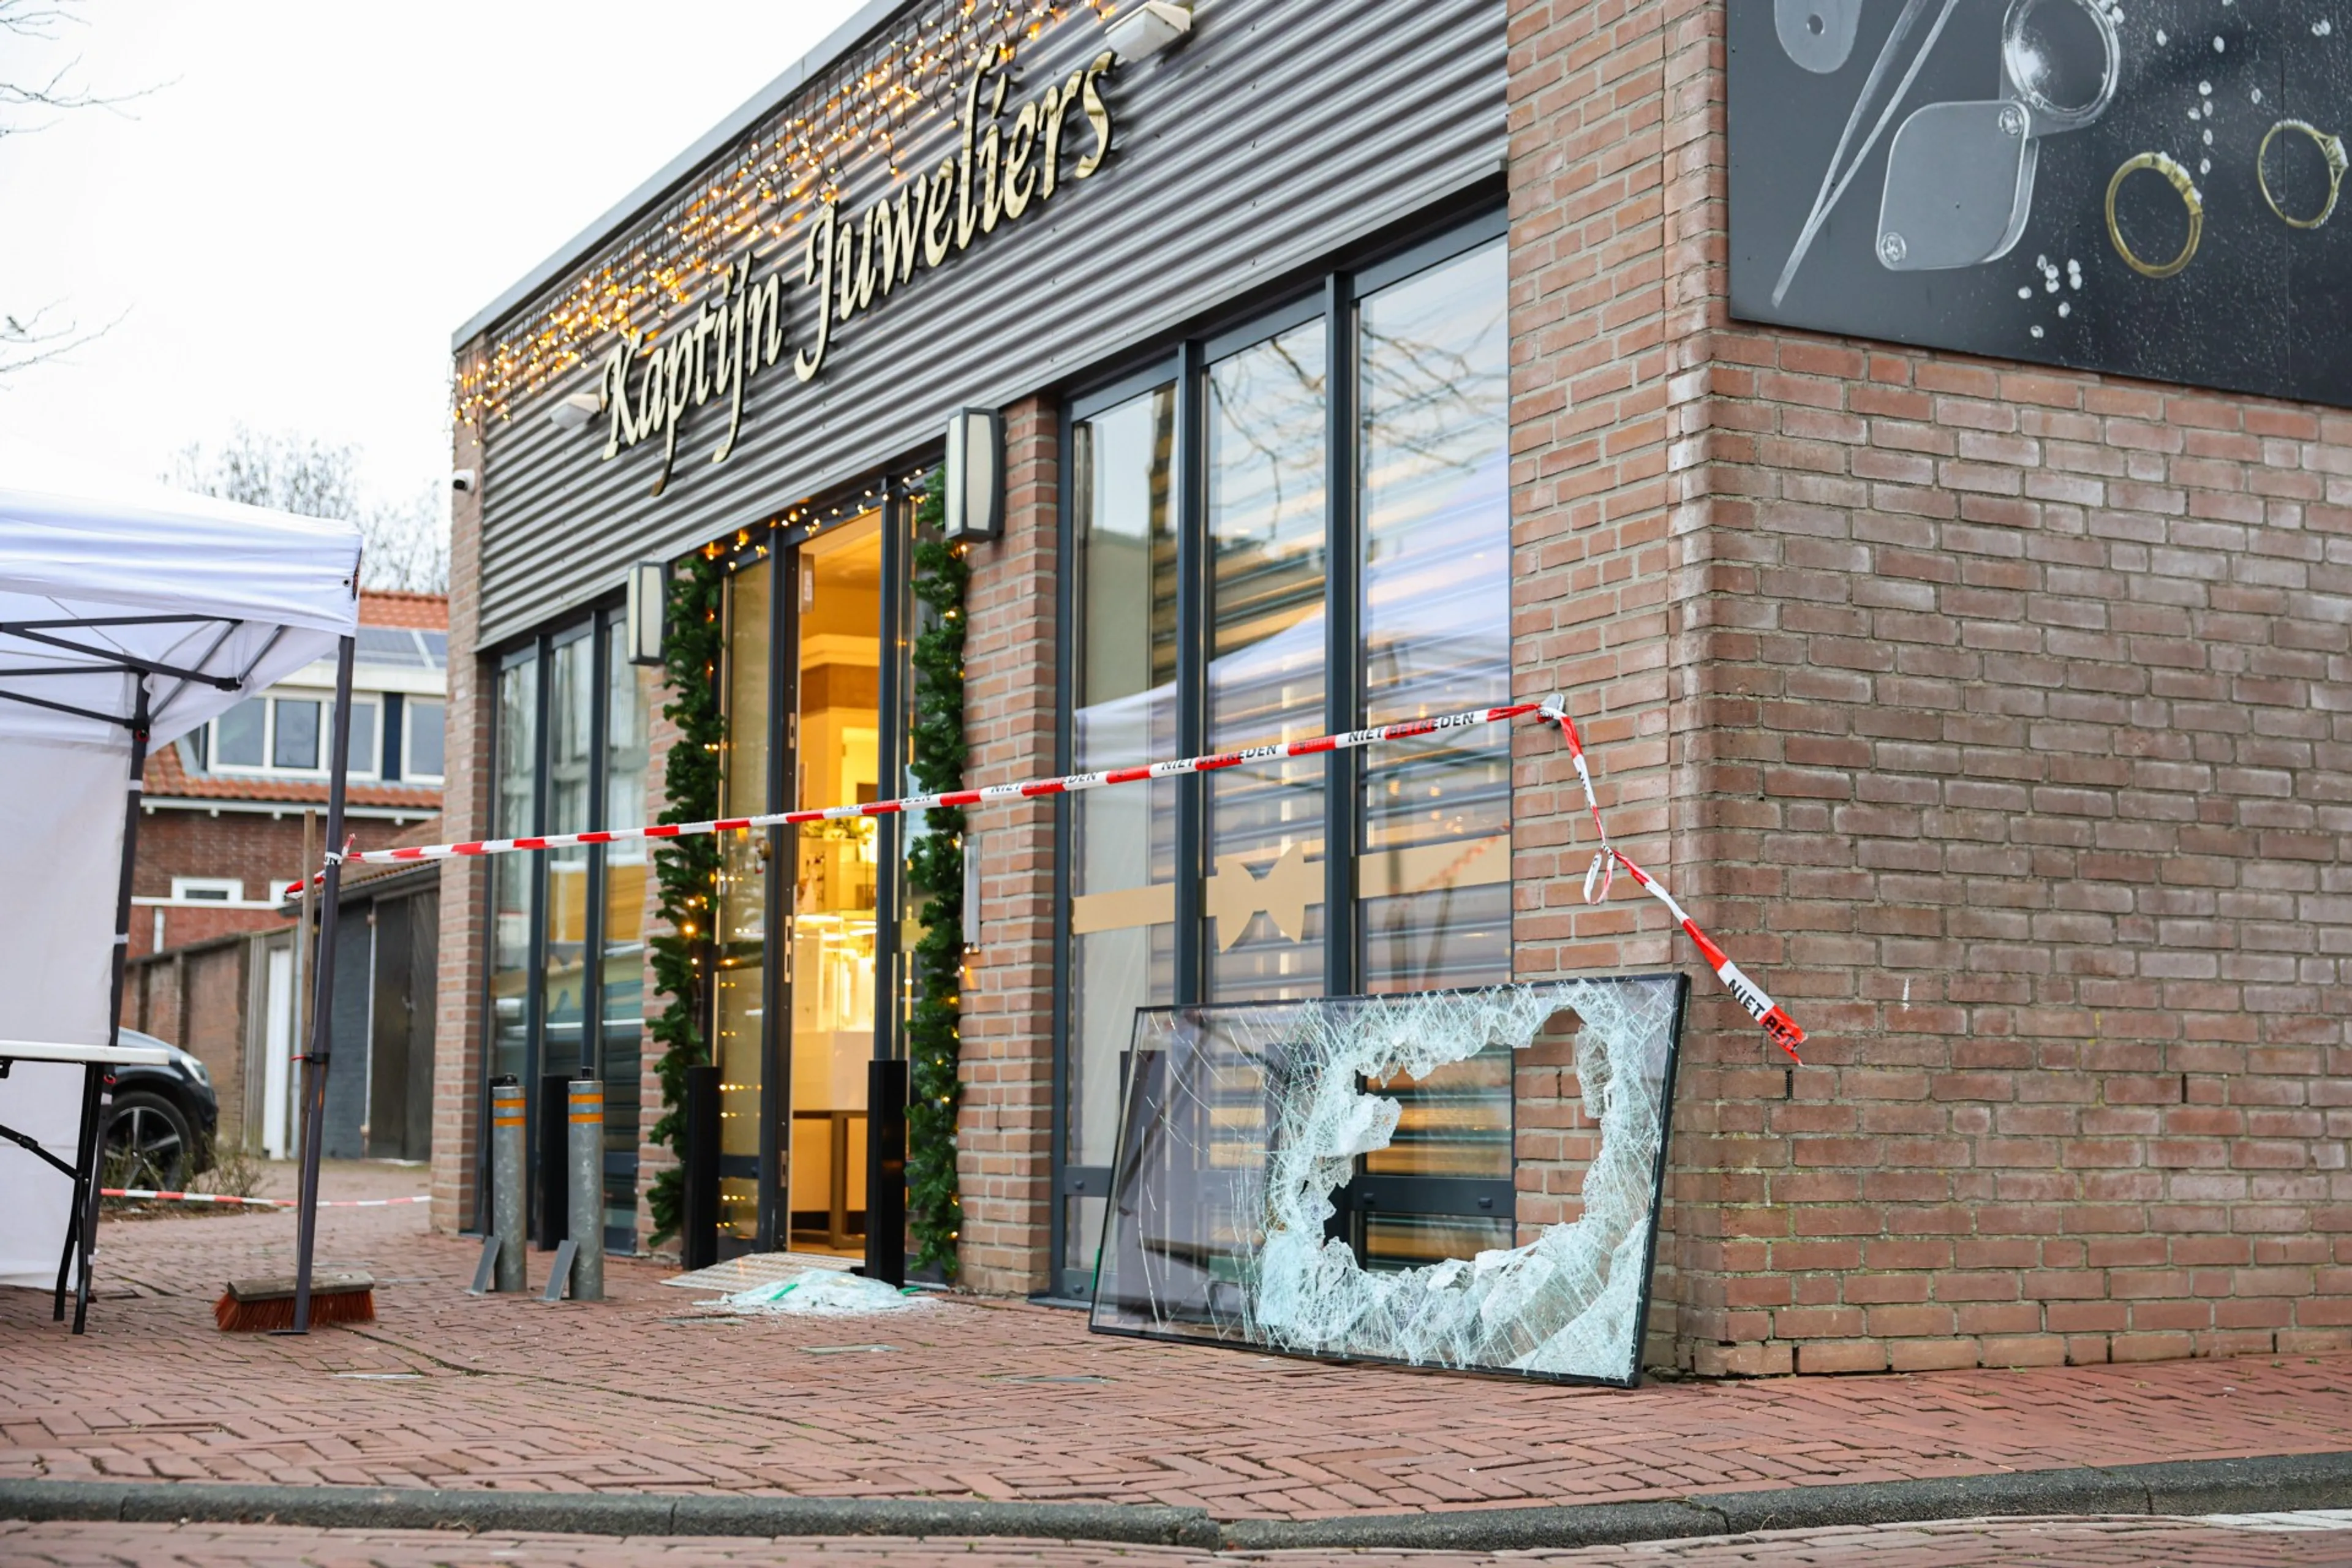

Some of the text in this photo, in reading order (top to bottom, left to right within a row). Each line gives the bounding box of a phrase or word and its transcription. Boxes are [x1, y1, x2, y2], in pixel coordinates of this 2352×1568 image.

[601, 44, 1118, 497] Kaptijn Juweliers
[1349, 714, 1475, 742] NIET BETREDEN
[1728, 979, 1765, 1017] NIET
